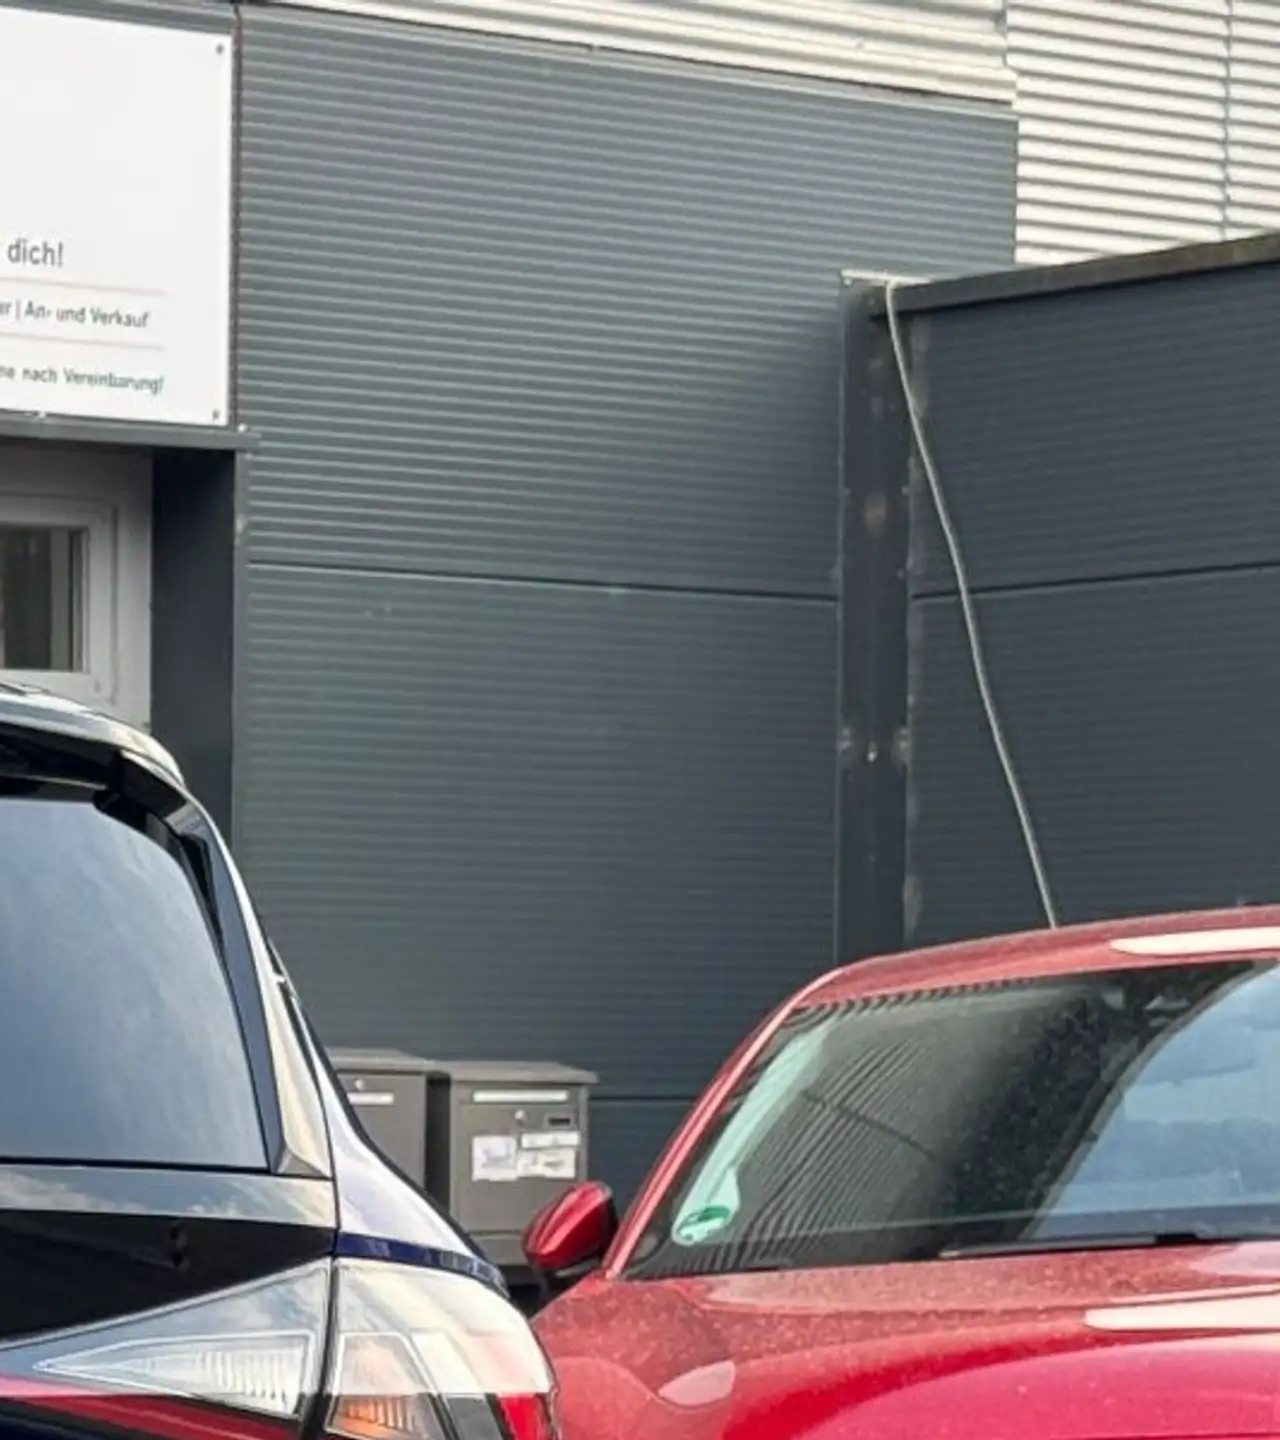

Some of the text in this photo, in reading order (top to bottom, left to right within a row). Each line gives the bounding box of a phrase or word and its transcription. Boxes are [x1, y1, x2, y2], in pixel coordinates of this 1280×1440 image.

[7, 238, 64, 268] dich!
[56, 306, 86, 324] und
[89, 307, 149, 328] Verkauf
[22, 367, 58, 384] nach
[62, 367, 165, 396] Vereinbarung!
